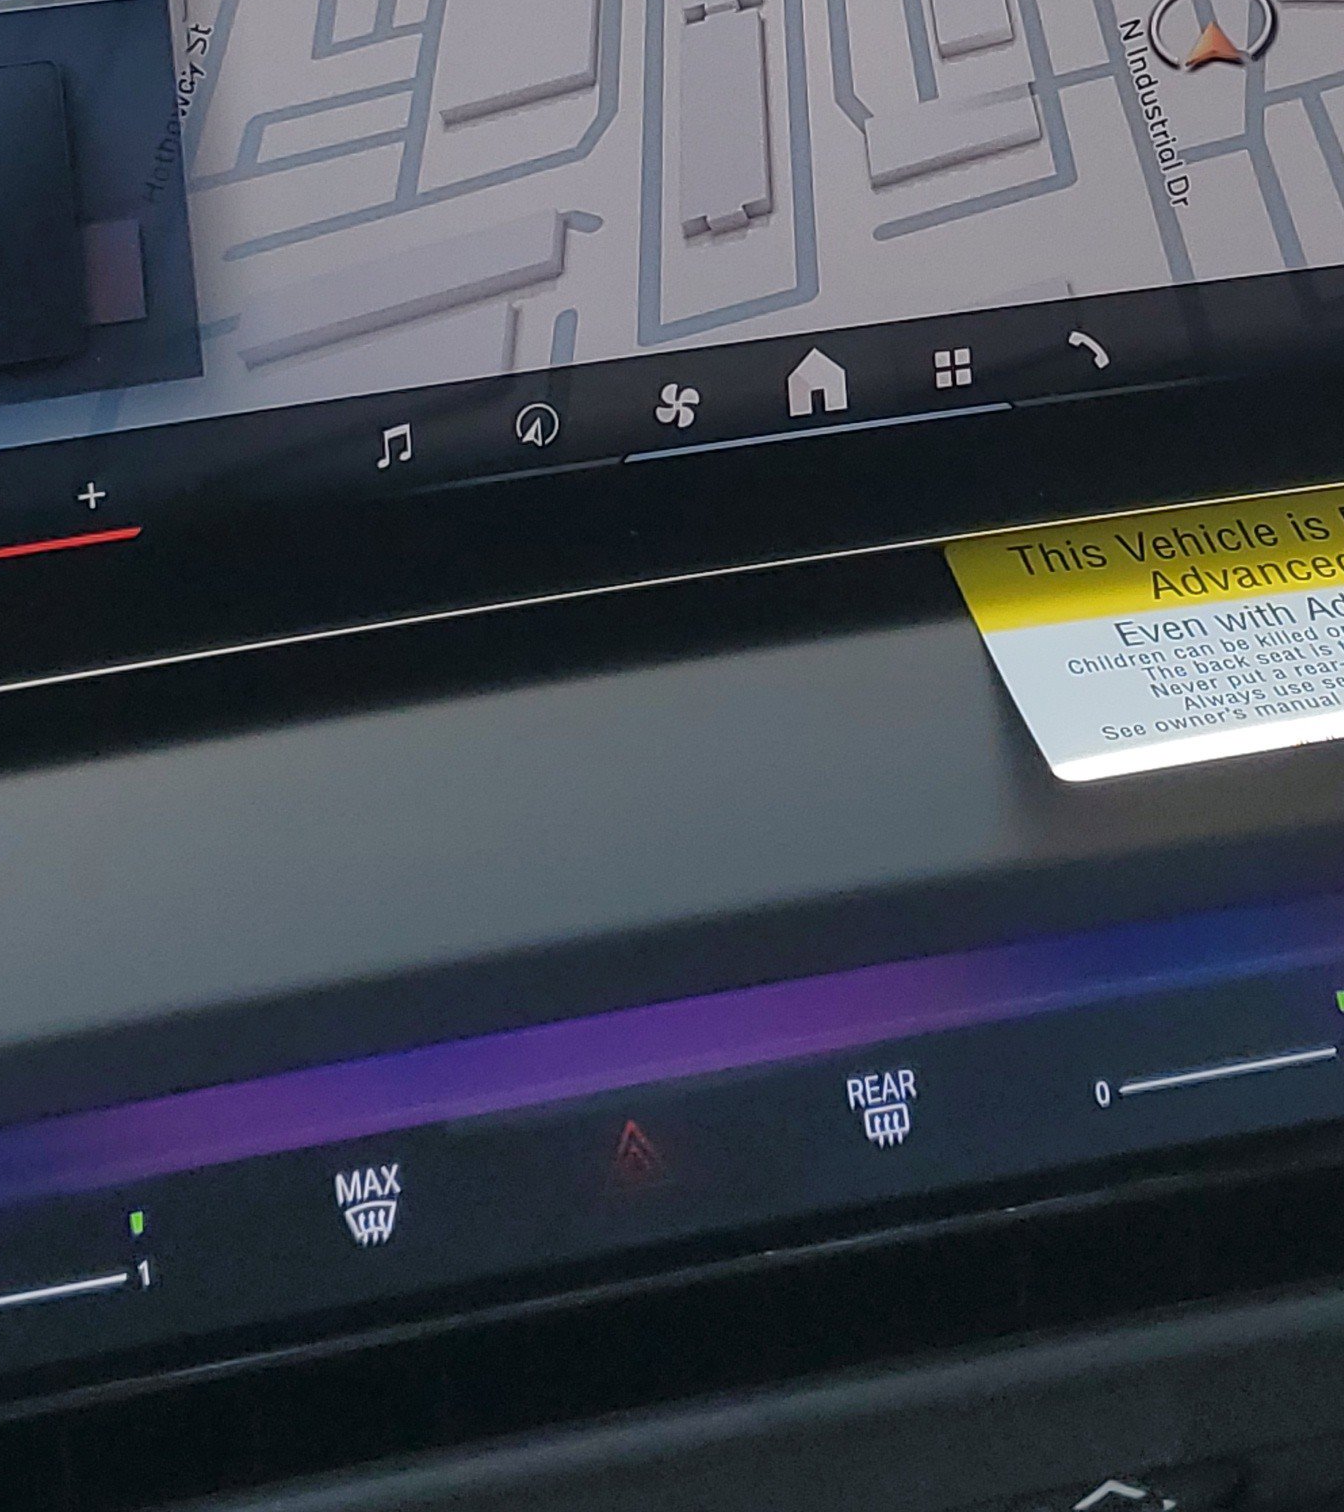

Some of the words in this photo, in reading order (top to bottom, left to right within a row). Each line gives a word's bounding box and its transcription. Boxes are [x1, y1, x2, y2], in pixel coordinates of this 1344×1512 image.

[185, 23, 212, 55] St
[1119, 19, 1144, 41] N
[1127, 47, 1183, 171] Industrial
[1166, 175, 1190, 207] Dr
[1006, 539, 1108, 575] This
[1114, 518, 1279, 563] Vehicle
[1286, 512, 1331, 542] is
[1113, 618, 1207, 647] Even
[1214, 601, 1297, 633] with
[1067, 649, 1166, 675] Children
[1174, 642, 1214, 660] can
[1219, 638, 1250, 653] be
[1254, 627, 1318, 648] killed
[1141, 666, 1188, 681] The
[1193, 655, 1251, 674] back
[1256, 647, 1305, 665] seat
[1309, 643, 1333, 657] is
[1149, 677, 1218, 698] Never
[1227, 669, 1267, 689] put
[1272, 669, 1287, 680] a
[1185, 688, 1266, 711] Always
[1273, 680, 1315, 697] use
[1101, 724, 1147, 741] See
[1155, 707, 1248, 733] owner's
[1256, 692, 1342, 718] manual
[845, 1068, 918, 1111] REAR
[1094, 1080, 1111, 1108] 0
[334, 1163, 402, 1206] MAX
[137, 1259, 151, 1287] 1
